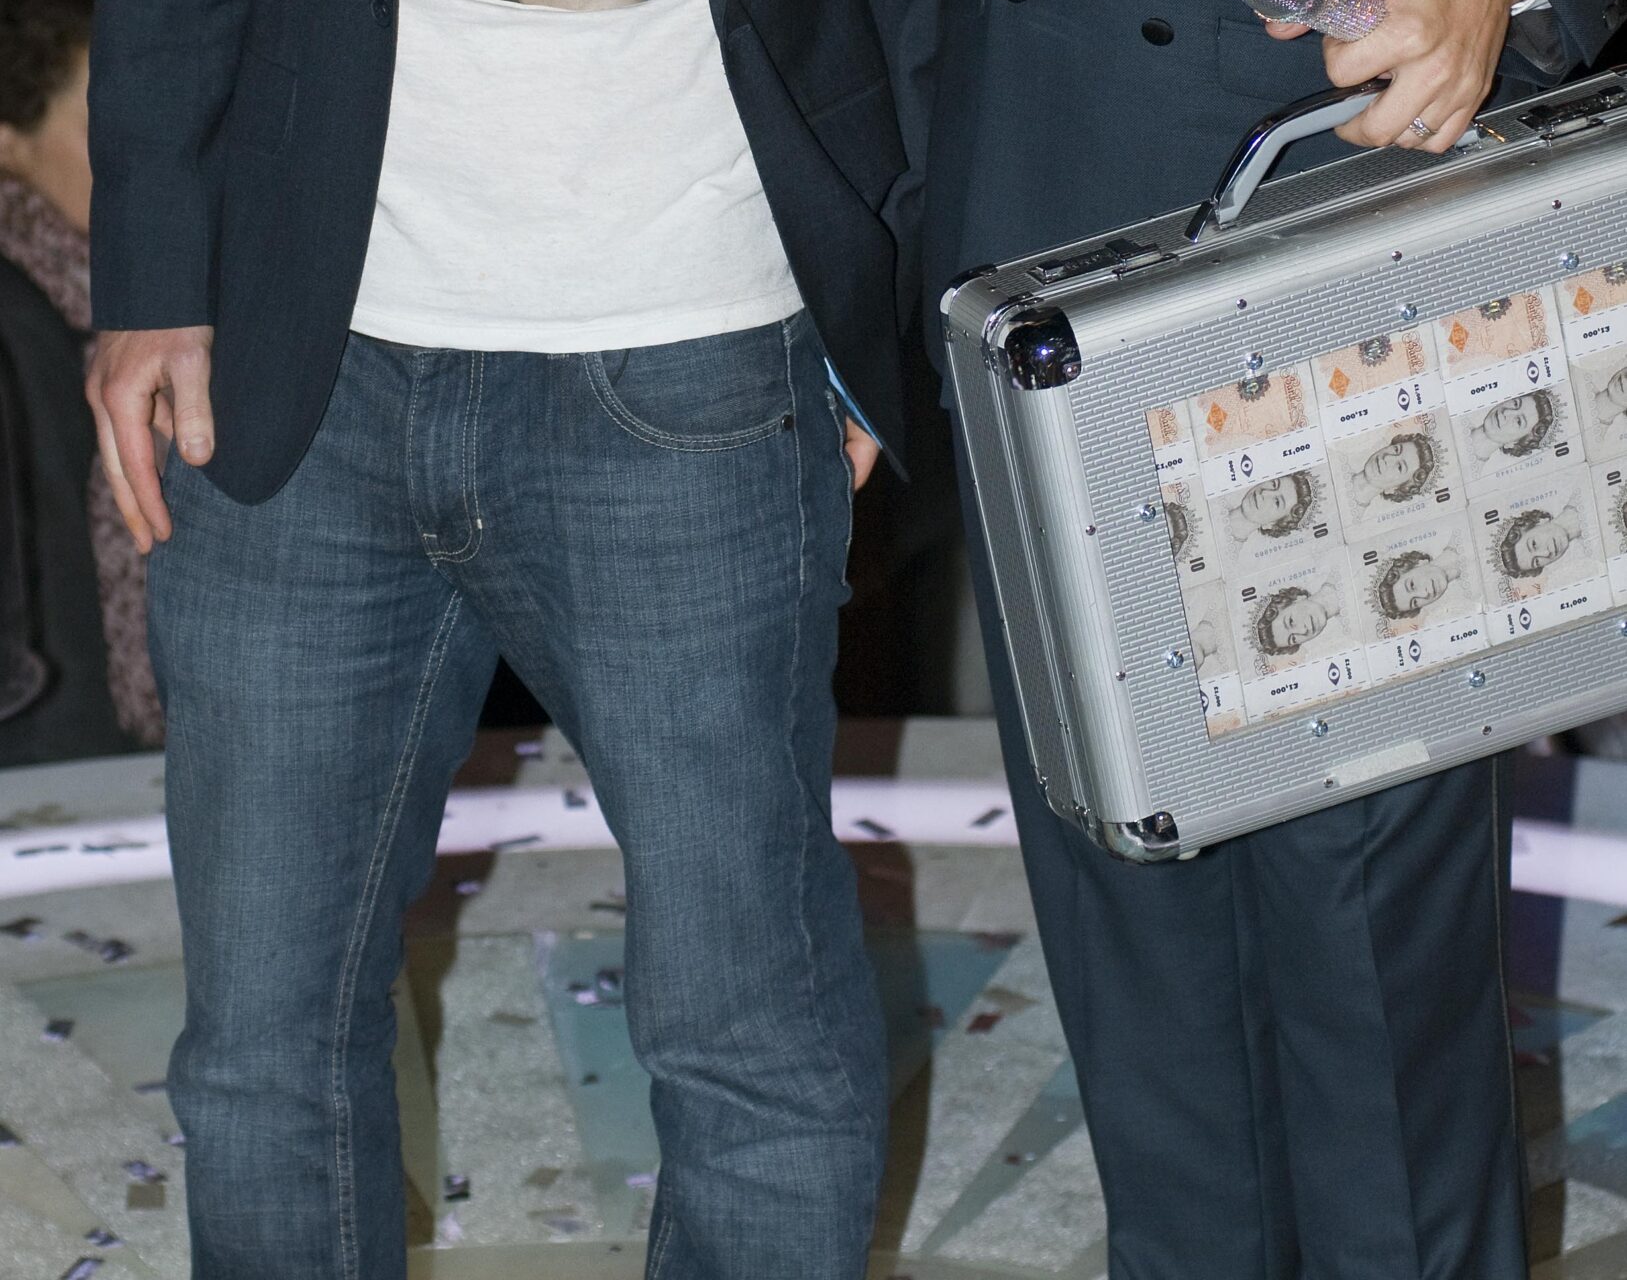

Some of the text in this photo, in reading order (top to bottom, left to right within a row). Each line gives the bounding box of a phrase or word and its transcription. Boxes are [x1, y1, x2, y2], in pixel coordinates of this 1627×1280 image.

[1583, 326, 1610, 339] £1,000
[1471, 381, 1498, 395] £1,000
[1340, 409, 1368, 422] £1,000
[1283, 444, 1310, 457] £1,000
[1554, 442, 1569, 457] 10
[1606, 470, 1622, 486] 10
[1435, 487, 1451, 503] 10
[1484, 509, 1500, 525] 10
[1312, 523, 1328, 539] 10
[1189, 557, 1205, 572] 10
[1362, 550, 1378, 566] 10
[1241, 587, 1257, 602] 10
[1560, 597, 1587, 610] £1,000
[1450, 629, 1478, 642] £1,000
[1271, 682, 1299, 696] £1,000
